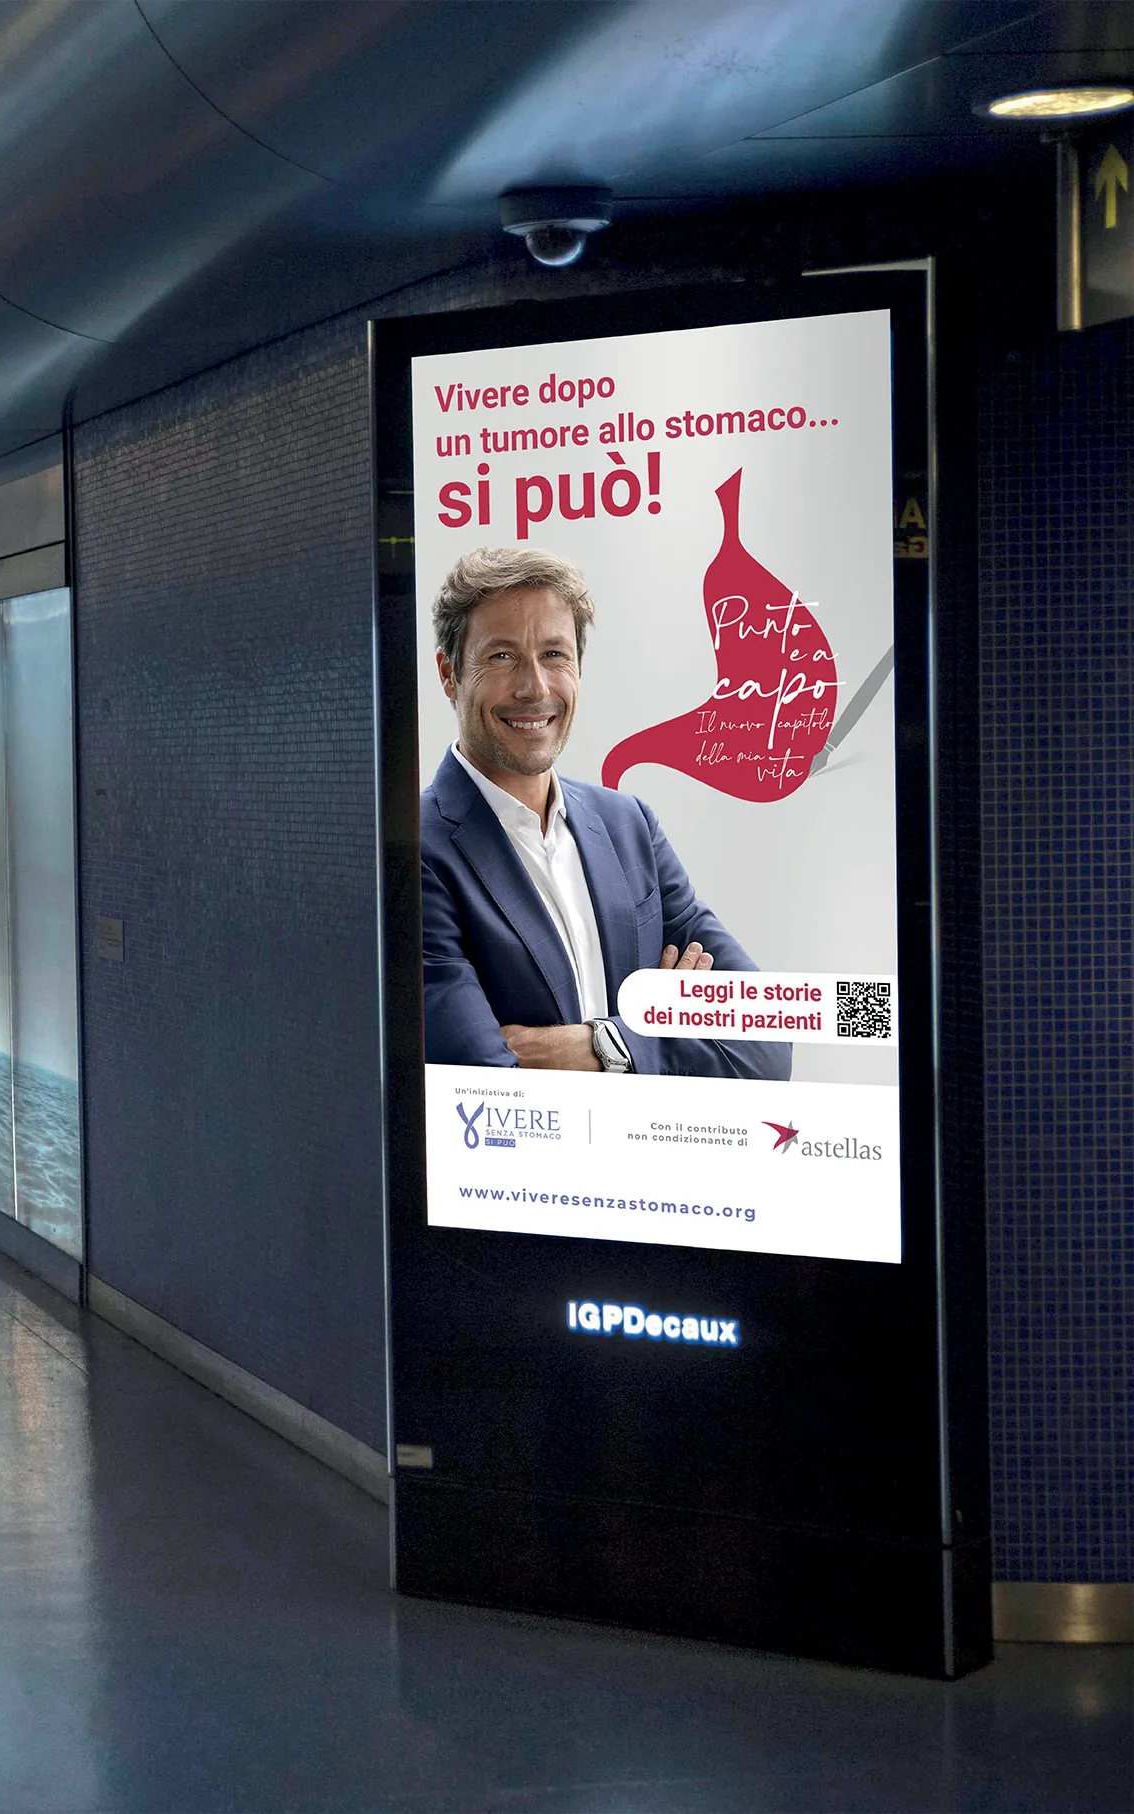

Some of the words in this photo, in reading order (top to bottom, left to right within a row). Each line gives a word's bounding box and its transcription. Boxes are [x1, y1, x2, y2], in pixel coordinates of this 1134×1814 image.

[434, 383, 530, 413] Vivere
[538, 373, 615, 408] dopo
[436, 433, 471, 457] un
[480, 424, 589, 454] tumore
[599, 411, 655, 445] allo
[665, 405, 839, 439] stomaco...
[437, 462, 491, 528] si
[515, 450, 662, 540] può!
[712, 590, 820, 654] Punto
[790, 648, 808, 661] e
[813, 649, 839, 661] a
[712, 668, 846, 750] capo
[695, 710, 717, 735] Il
[720, 720, 766, 732] nuovo
[777, 707, 834, 740] capitolo
[696, 740, 733, 766] della
[737, 751, 766, 763] mia
[757, 748, 805, 789] vita
[679, 979, 734, 1004] Leggi
[740, 980, 758, 1001] le
[763, 982, 823, 1003] storie
[643, 1005, 673, 1025] dei
[679, 1008, 736, 1028] nostri
[741, 1010, 822, 1033] pazienti
[455, 1087, 510, 1097] Un'iniziativa
[513, 1090, 525, 1098] di:
[485, 1129, 515, 1137] SENZA
[518, 1131, 562, 1140] STOMACO
[485, 1138, 494, 1146] SI
[497, 1138, 515, 1147] PUÒ
[627, 1132, 648, 1141] non
[652, 1133, 734, 1146] condizionante
[737, 1137, 748, 1147] di
[650, 1122, 671, 1131] Con
[675, 1122, 683, 1132] il
[687, 1124, 748, 1136] contributo
[801, 1137, 882, 1161] astellas
[459, 1186, 756, 1222] www.viveresenzastomaco.org
[566, 1301, 739, 1345] IGPDecaux
